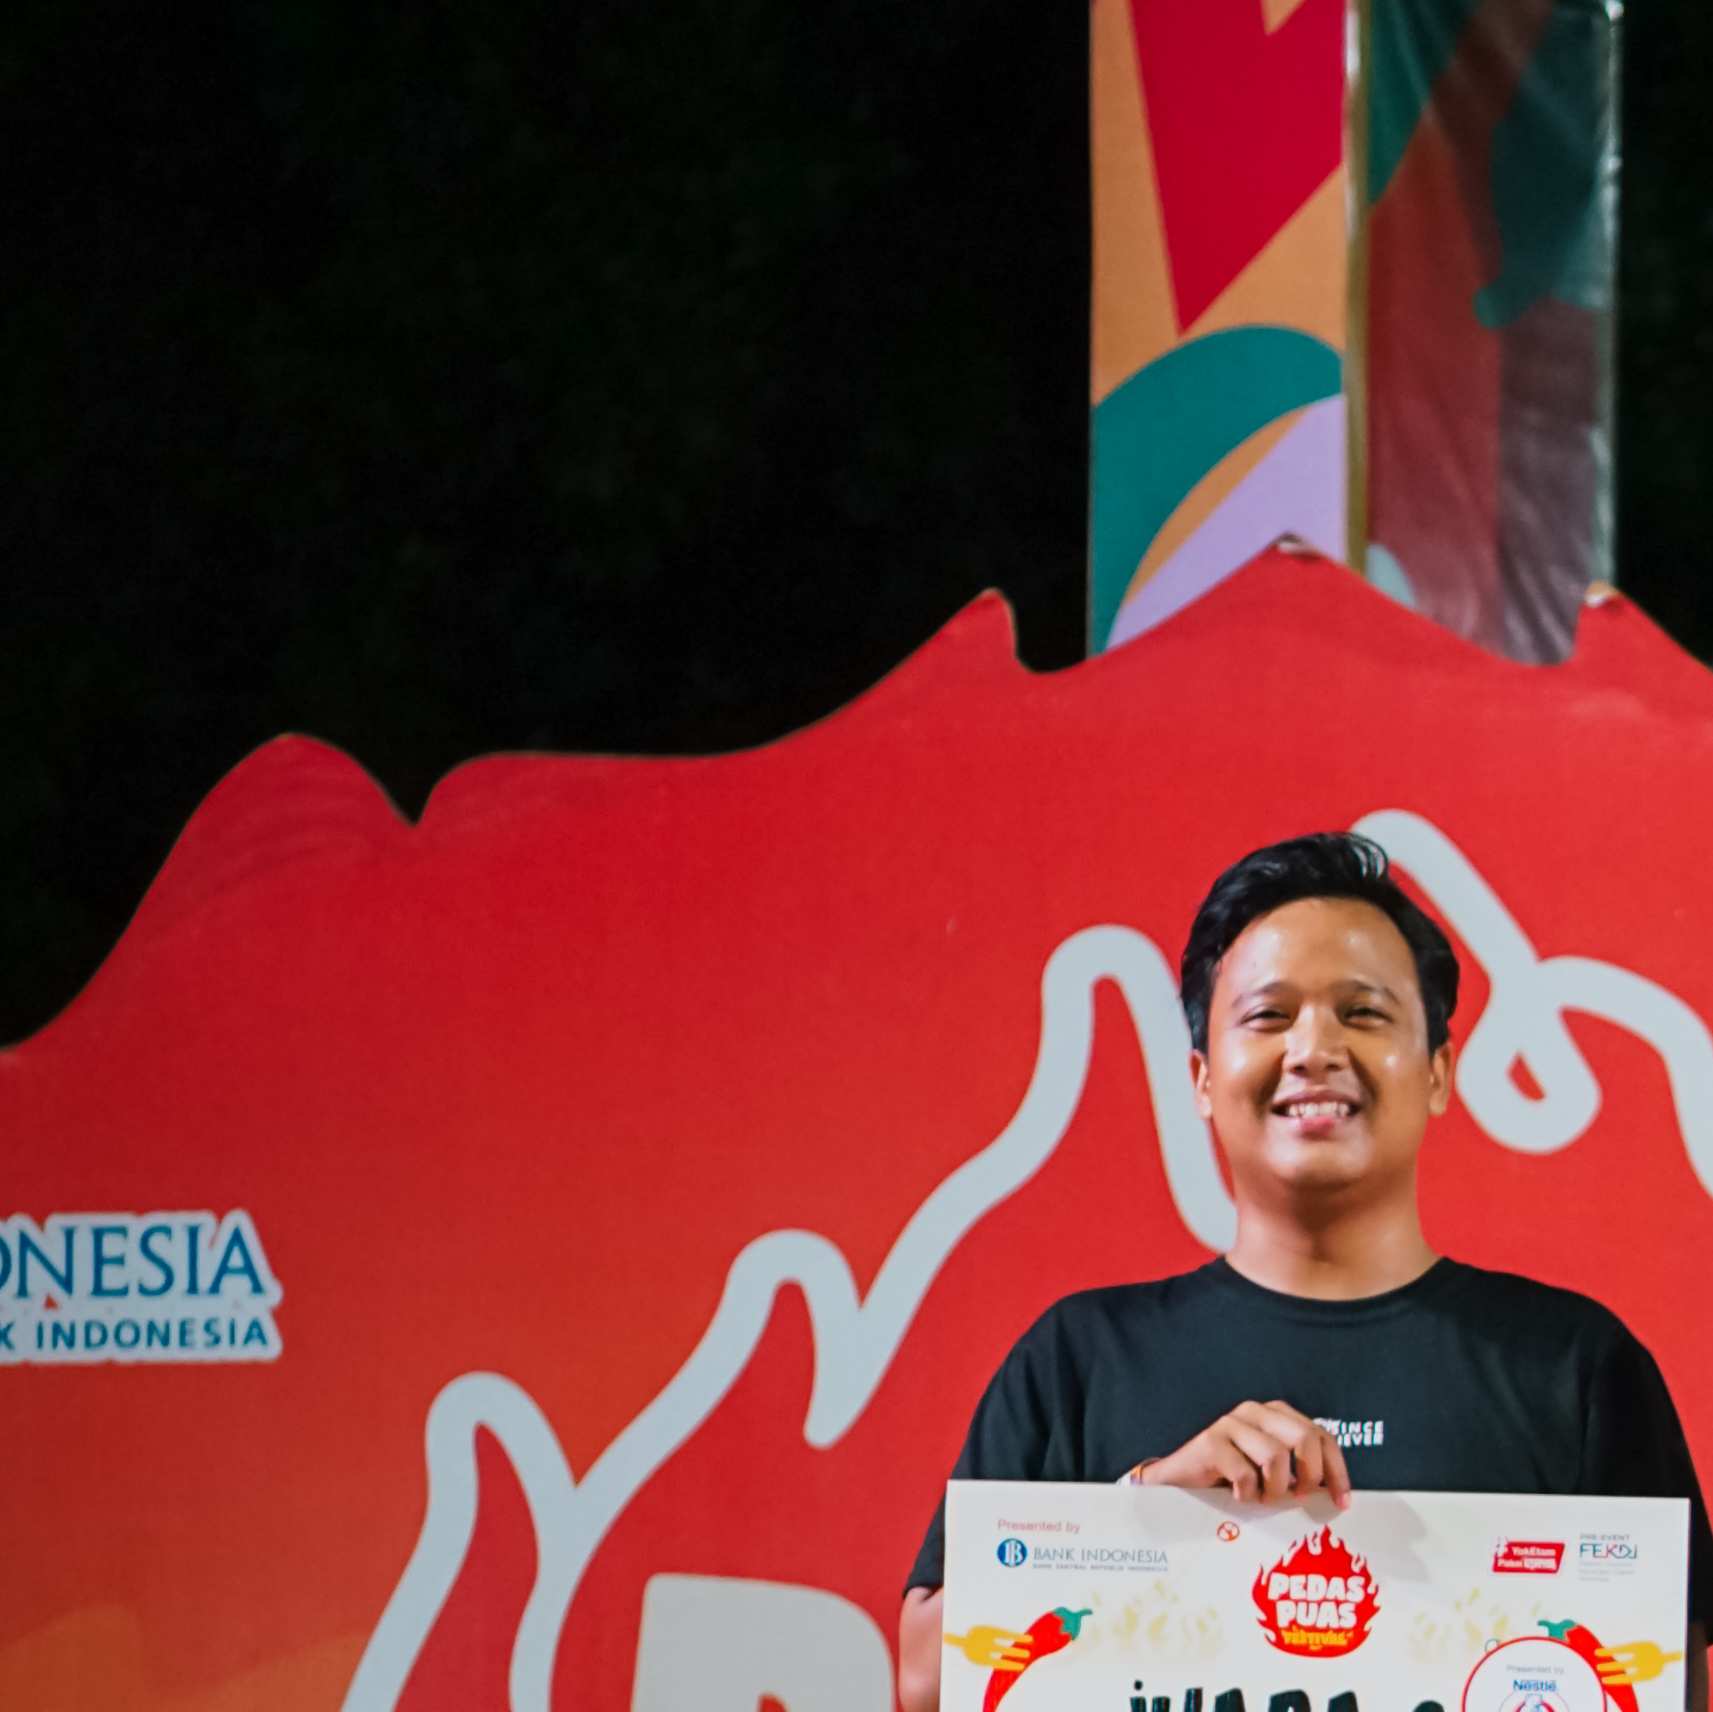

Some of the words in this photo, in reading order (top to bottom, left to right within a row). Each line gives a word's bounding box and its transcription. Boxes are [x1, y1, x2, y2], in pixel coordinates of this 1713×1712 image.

[0, 1224, 264, 1299] NESIA
[37, 1318, 268, 1350] INDONESIA
[997, 1519, 1062, 1532] Presented
[1066, 1521, 1081, 1534] by
[1033, 1548, 1075, 1562] BANK
[1081, 1548, 1169, 1564] INDONESIA
[1268, 1572, 1366, 1603] PEDAS
[1276, 1601, 1357, 1630] PUAS
